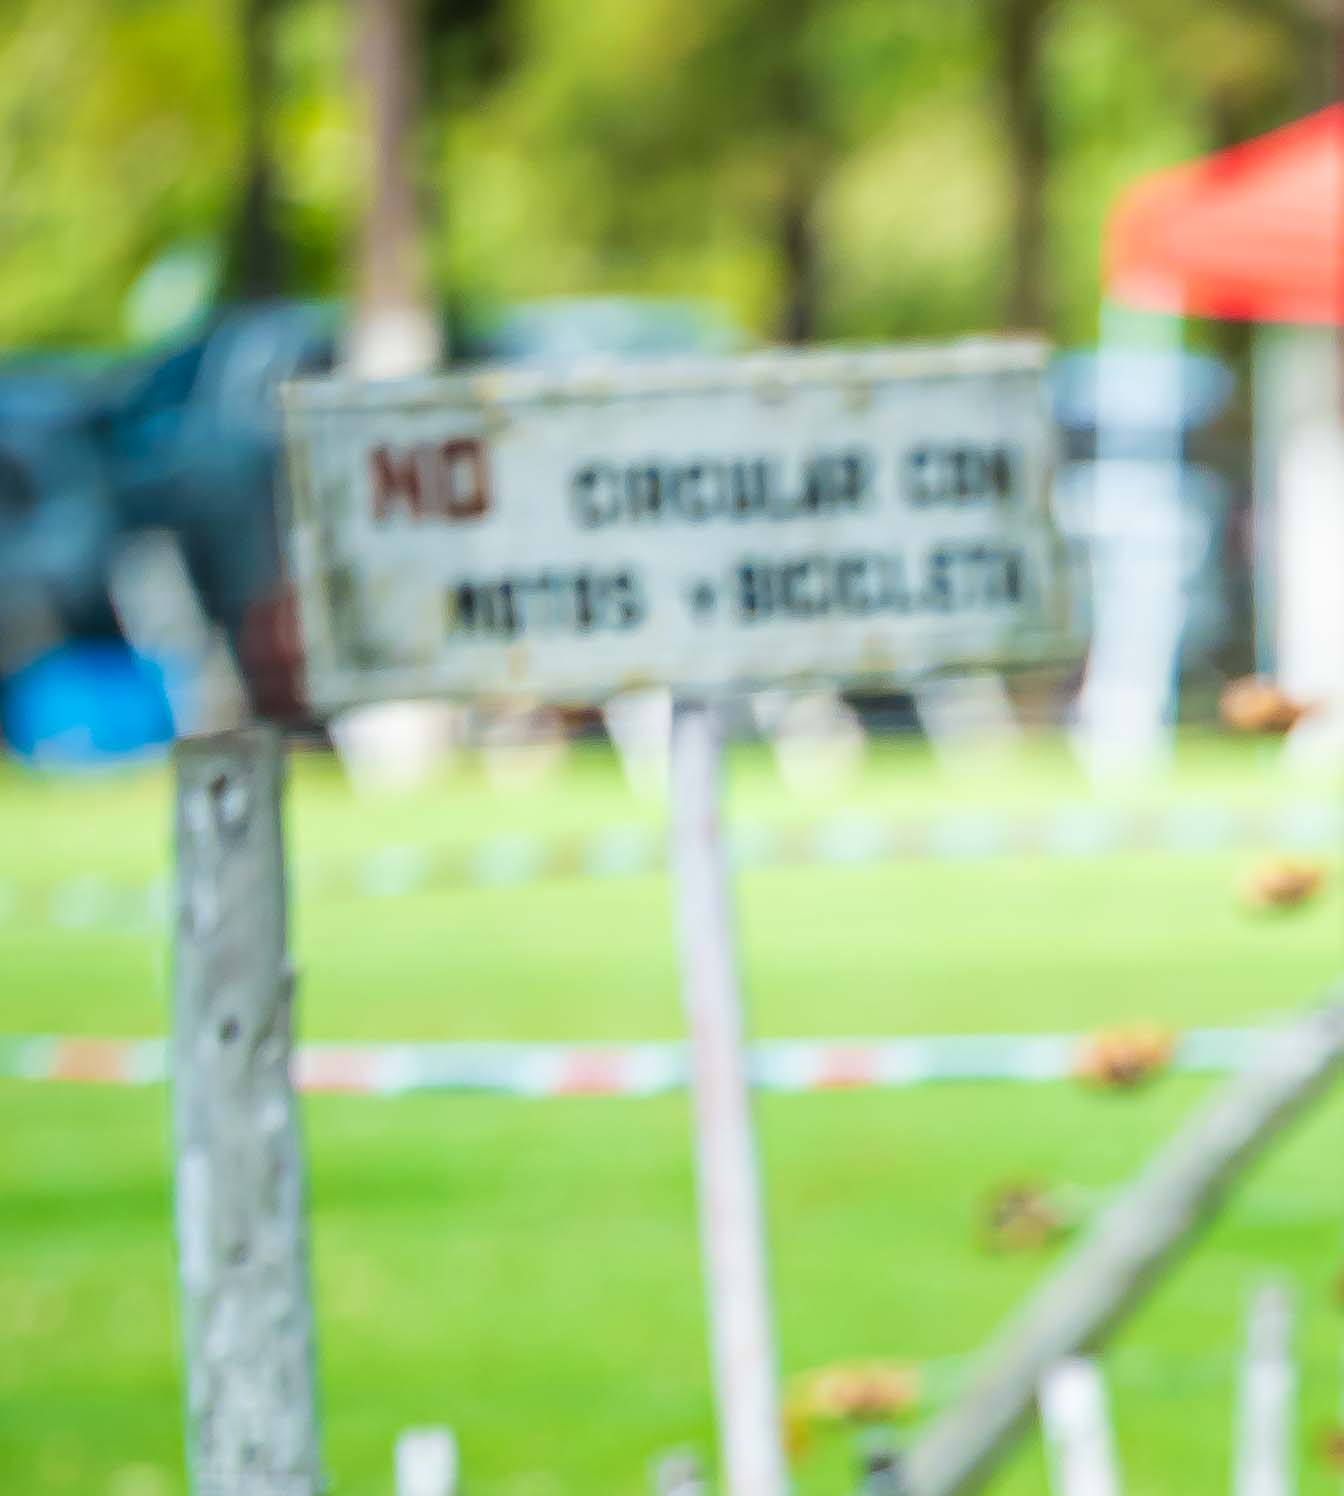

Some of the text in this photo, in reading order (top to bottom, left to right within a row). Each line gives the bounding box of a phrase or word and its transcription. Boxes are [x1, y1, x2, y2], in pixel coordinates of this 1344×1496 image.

[370, 438, 1014, 529] NO CIRCULAR CON
[449, 568, 641, 636] MOTOS
